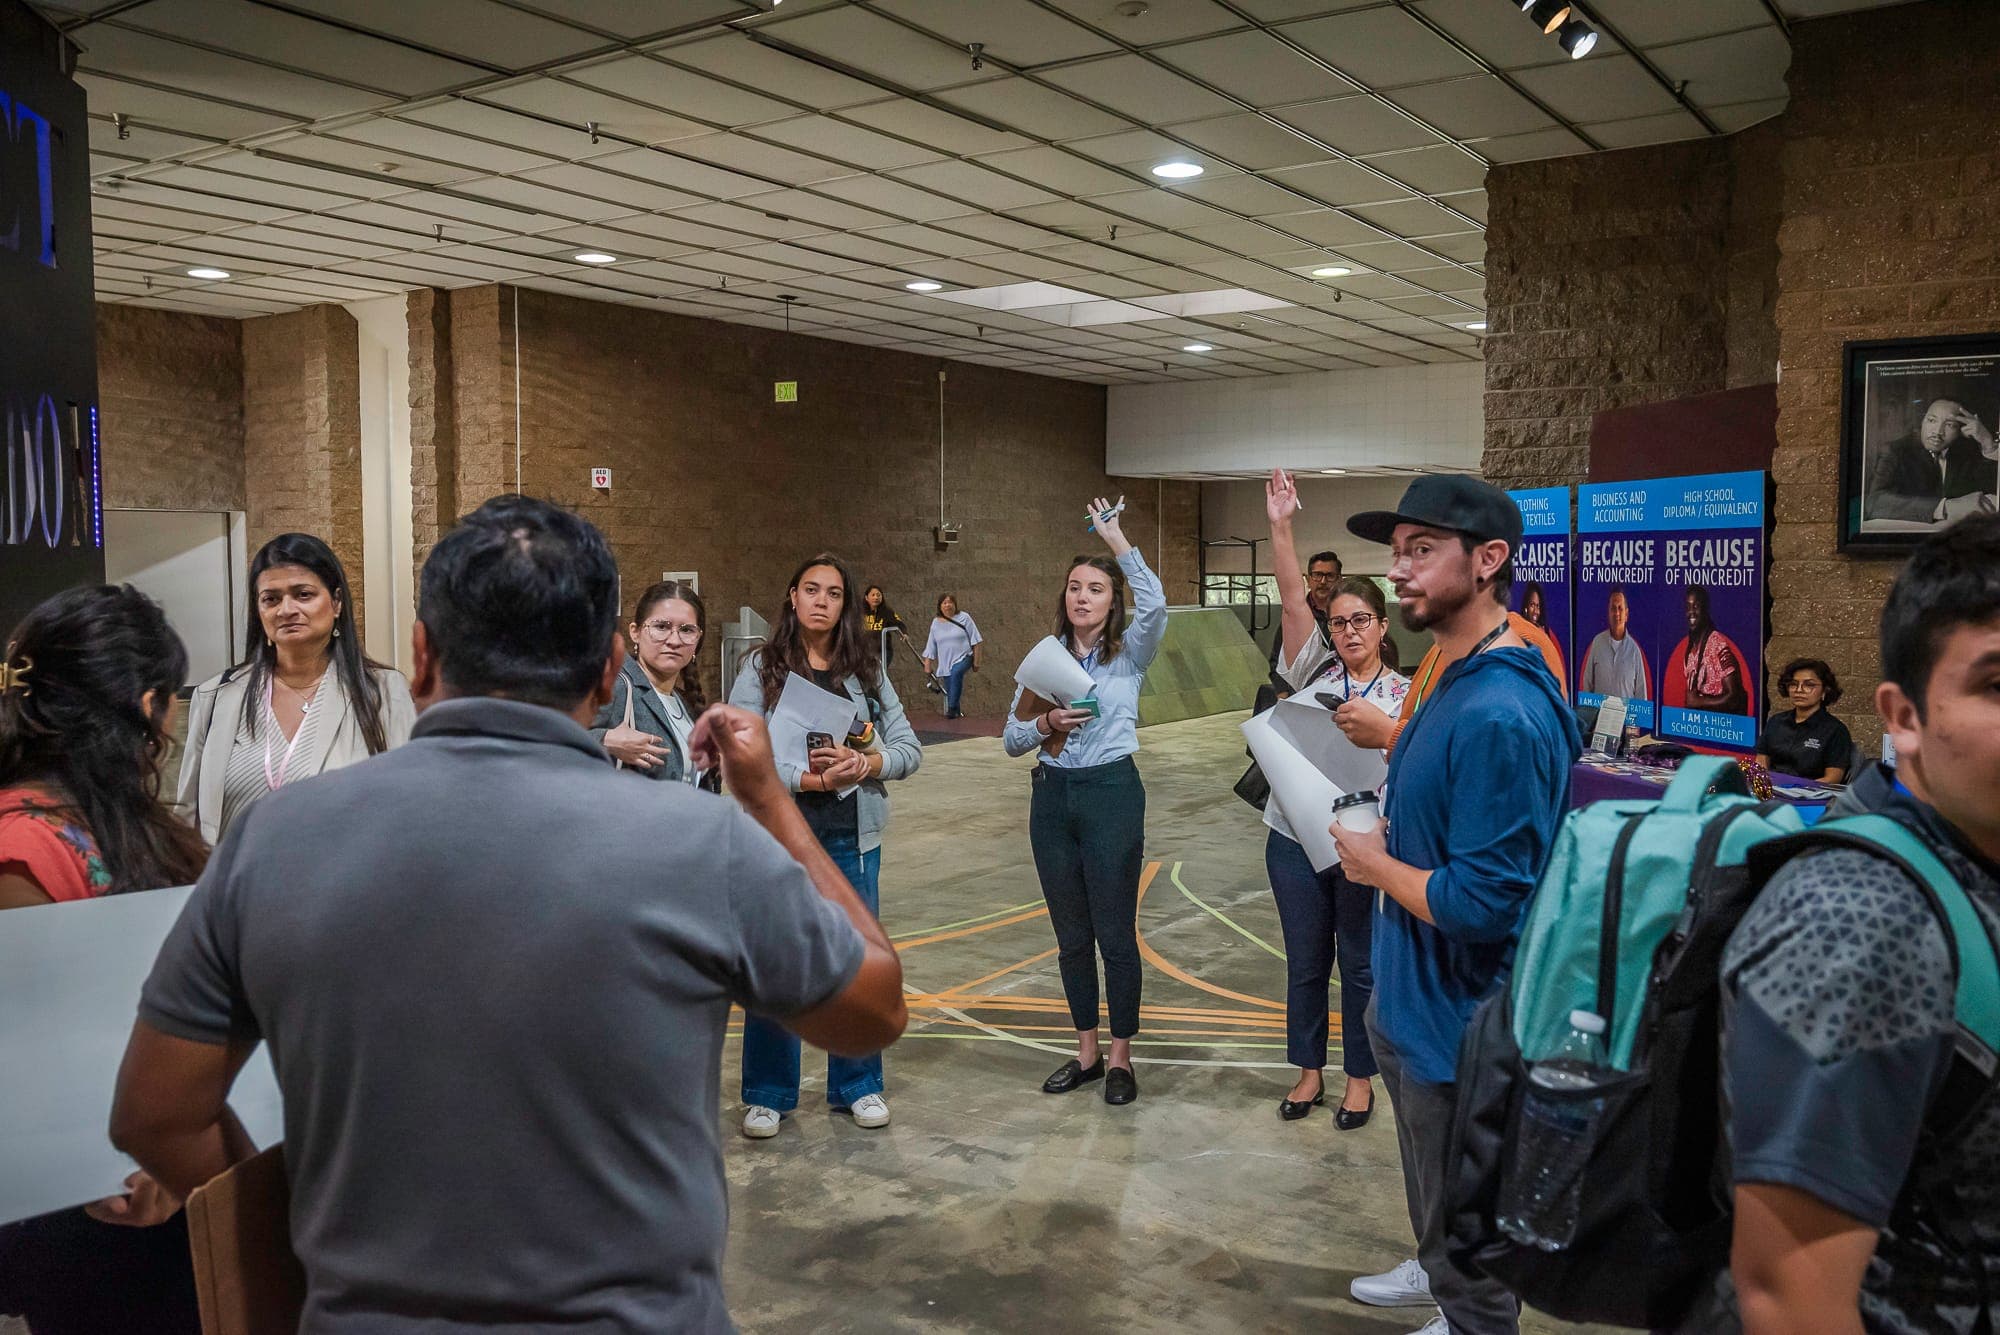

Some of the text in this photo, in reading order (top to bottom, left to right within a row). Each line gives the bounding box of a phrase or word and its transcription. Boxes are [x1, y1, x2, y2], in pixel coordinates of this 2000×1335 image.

[1592, 490, 1647, 507] BUSINESS AND
[1684, 488, 1735, 503] HIGH SCHOOL
[1594, 507, 1644, 523] ACCOUNTING
[1663, 505, 1696, 518] DIPLOMA
[1704, 501, 1758, 518] EQUIVALENCY
[1526, 512, 1556, 526] TEXTILES
[1511, 542, 1565, 567] ECAUSE
[1582, 540, 1655, 566] BECAUSE
[1665, 538, 1755, 567] BECAUSE
[1515, 567, 1565, 583] NONCREDIT
[1582, 566, 1655, 584] OF NONCREDIT
[1665, 568, 1755, 587] OF NONCREDIT
[1688, 713, 1701, 723] AM
[1703, 714, 1709, 725] A
[1711, 715, 1732, 728] HIGH
[1671, 722, 1745, 741] SCHOOL STUDENT
